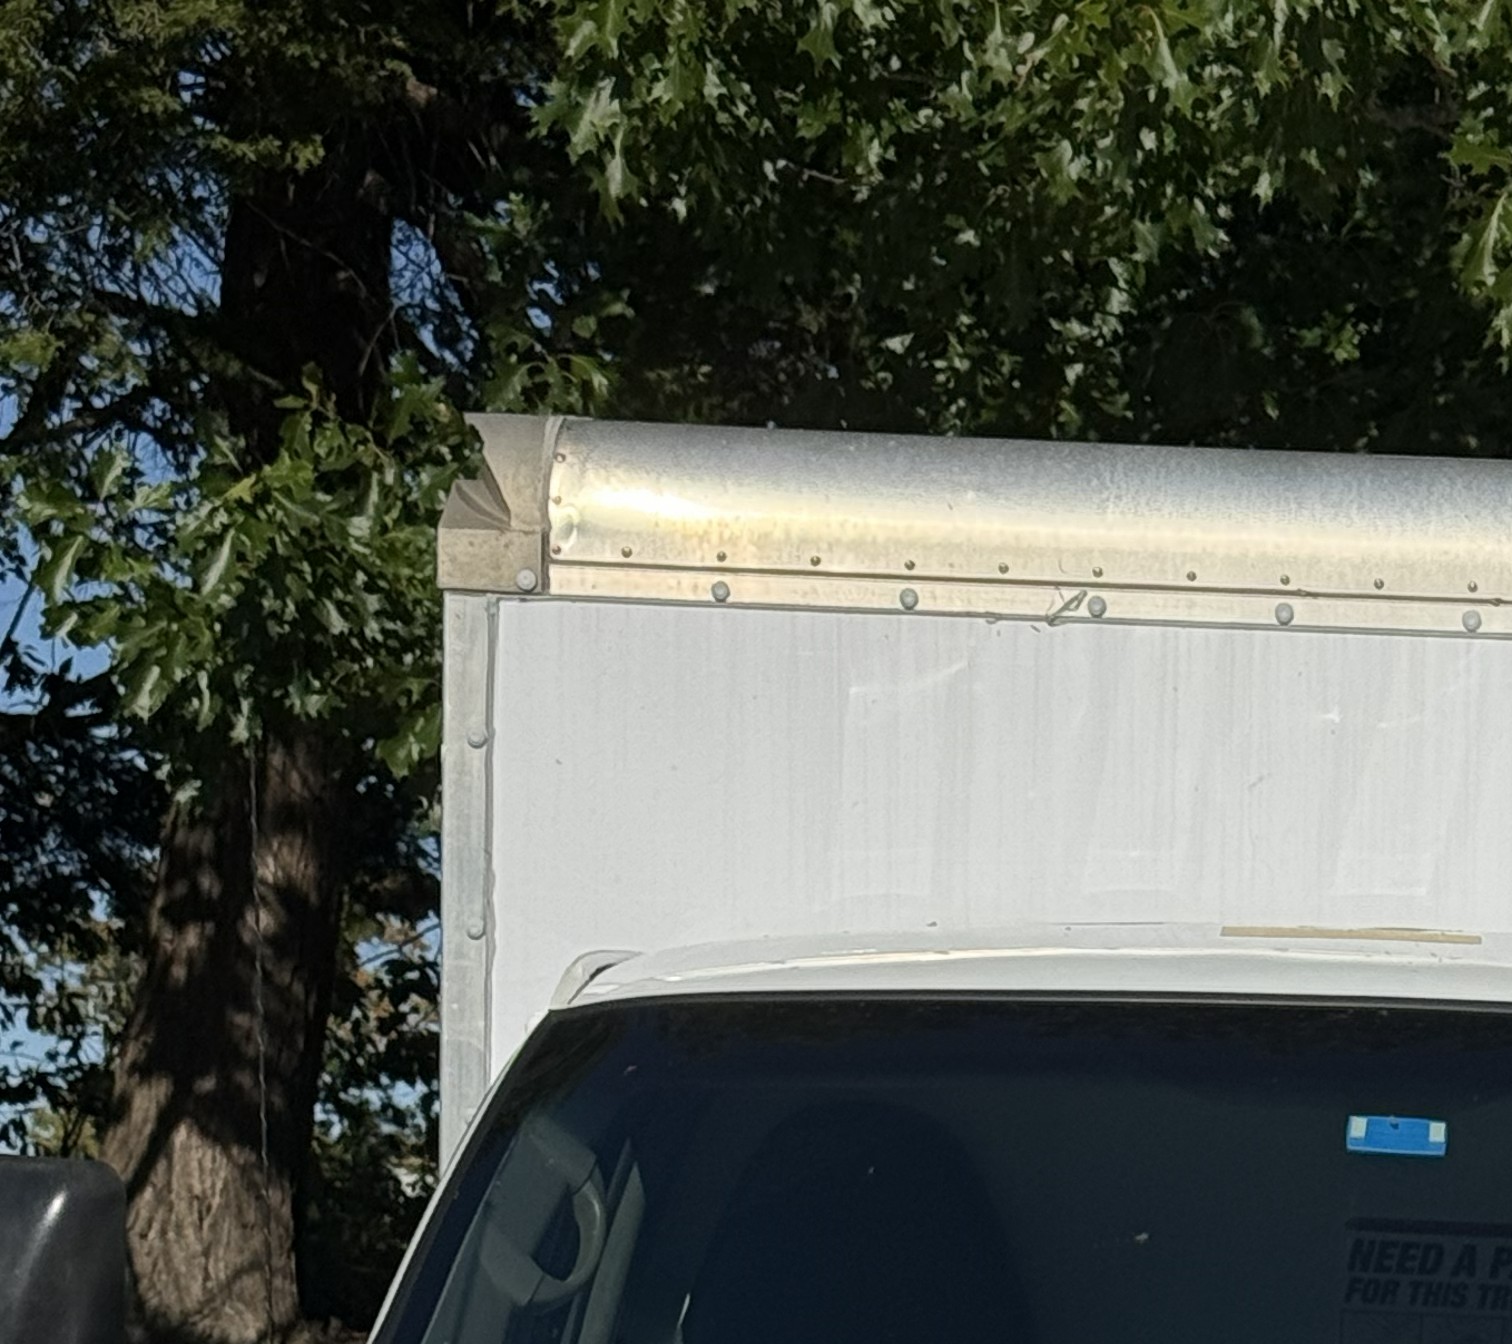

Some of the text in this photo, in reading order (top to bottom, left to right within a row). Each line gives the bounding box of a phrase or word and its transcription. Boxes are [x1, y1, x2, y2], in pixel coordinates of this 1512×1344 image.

[1347, 1239, 1445, 1276] NEED
[1450, 1244, 1478, 1278] A
[1344, 1277, 1400, 1304] FOR
[1407, 1280, 1469, 1309] THIS
